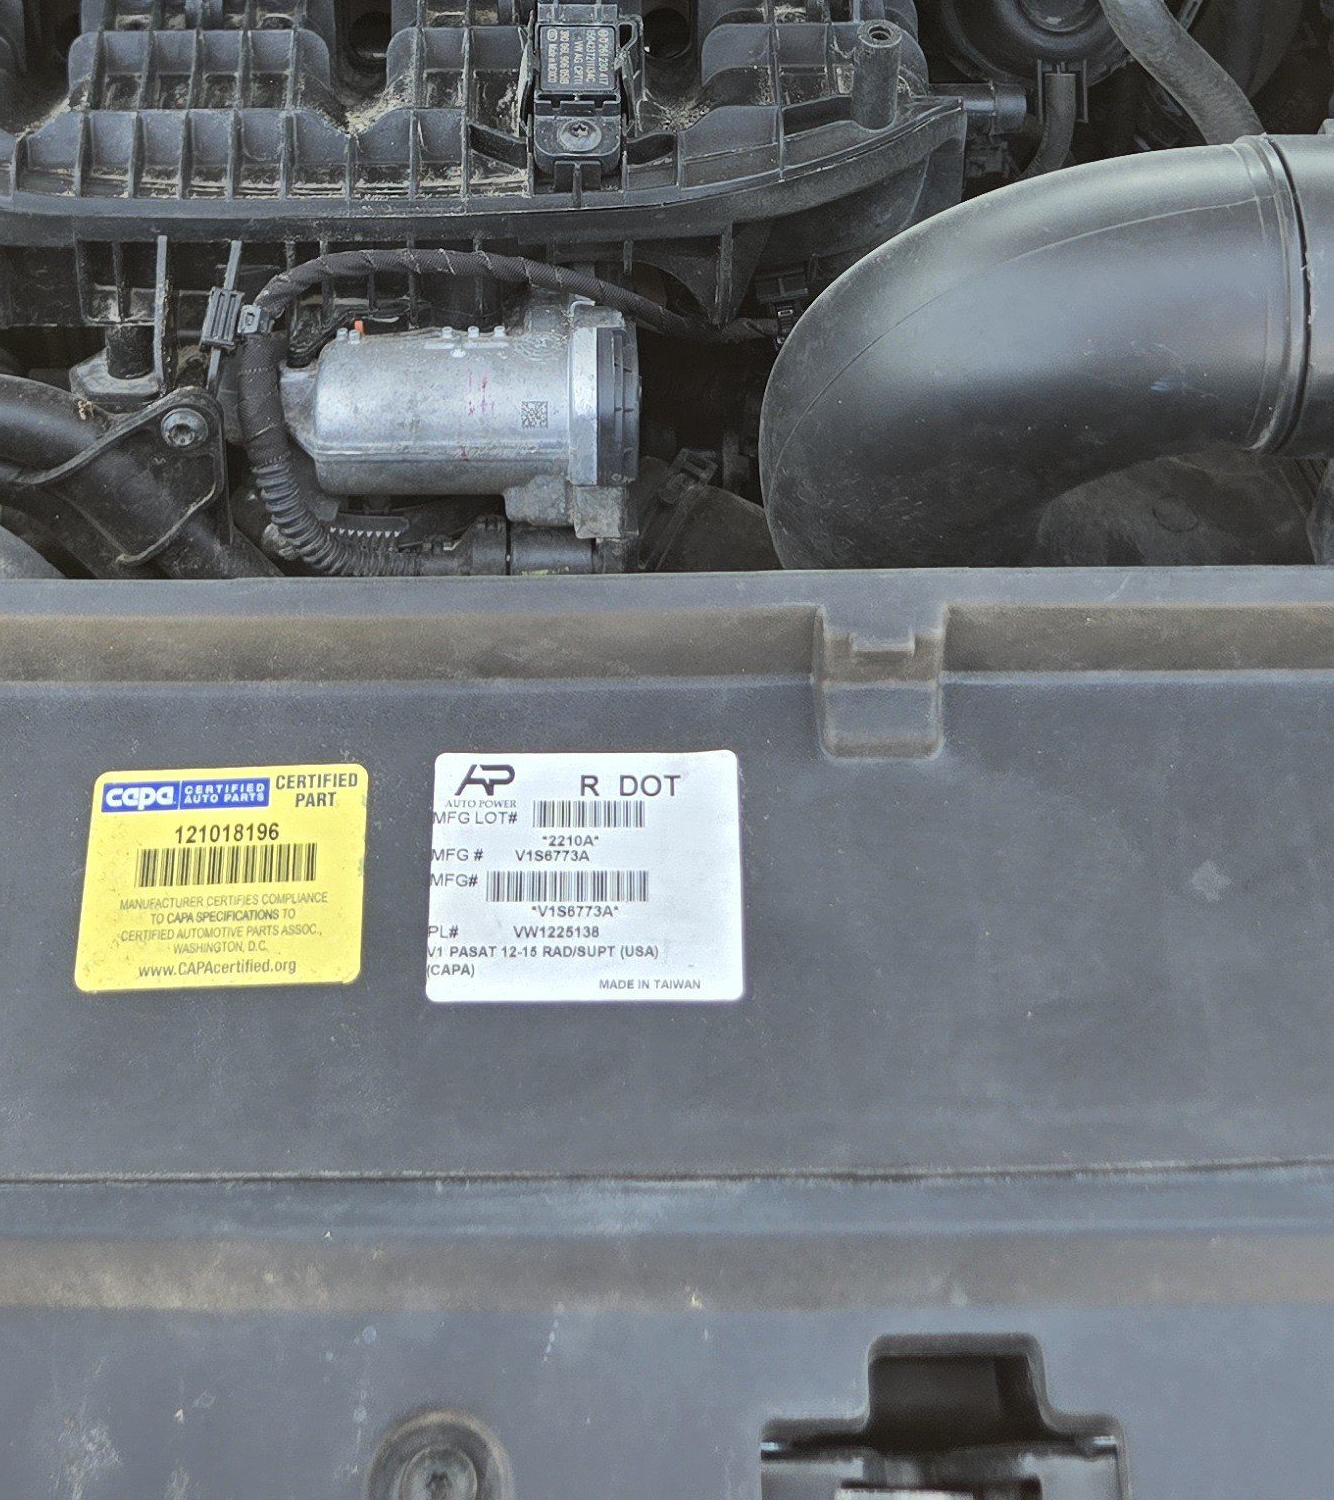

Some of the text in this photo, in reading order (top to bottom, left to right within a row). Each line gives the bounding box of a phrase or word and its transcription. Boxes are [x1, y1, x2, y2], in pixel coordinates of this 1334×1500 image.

[184, 783, 265, 795] CERTIFIED
[275, 773, 358, 790] CERTIFIED
[580, 775, 682, 797] R DOT
[183, 792, 265, 804] AUTO PARTS
[295, 792, 337, 808] PART
[445, 799, 517, 809] AUTO POWER
[432, 810, 518, 825] MFG LOT#
[174, 822, 280, 844] 121018196
[430, 848, 591, 863] MFG # V1S6773A
[429, 872, 479, 888] MFG#
[120, 891, 328, 911] MANUFACTURER CERTIFIES COMPLIANCE
[150, 908, 296, 925] TO CAPA SPECIFICATIONS TO
[120, 928, 175, 942] CERTIFIED
[176, 926, 245, 940] AUTOMOTIVE
[246, 924, 279, 937] PARTS
[427, 924, 600, 939] PL# VW1225138
[449, 946, 497, 959] PASAT
[501, 946, 538, 959] 12-15
[542, 945, 616, 959] RAD/SUPT
[619, 944, 660, 960] (USA)
[137, 958, 298, 978] www.CAPAcertified.org
[425, 963, 476, 978] (CAPA)
[599, 978, 702, 990] MADE IN TAIWAN
